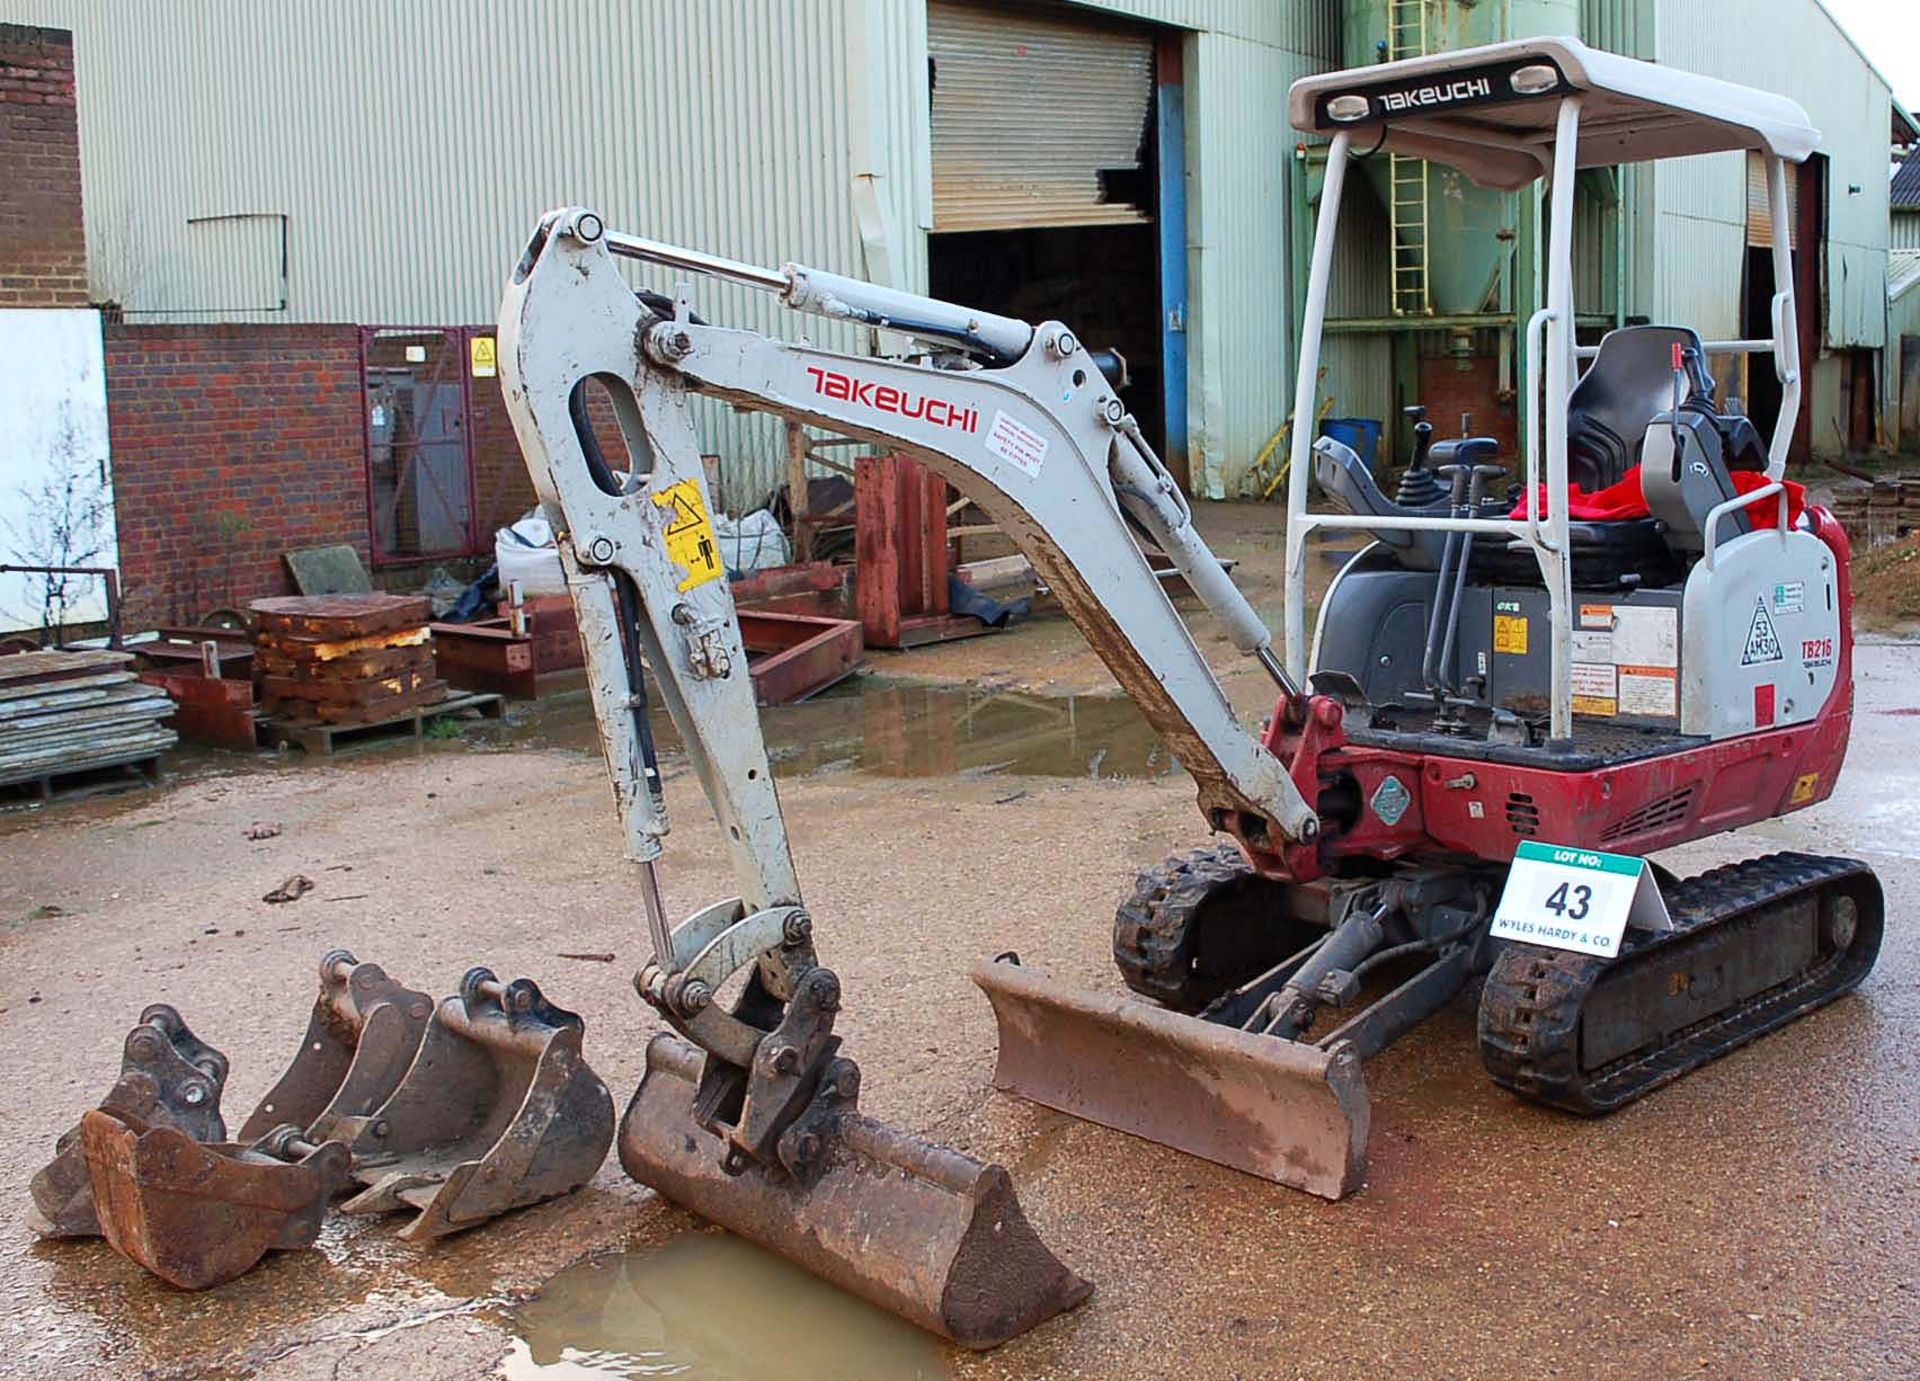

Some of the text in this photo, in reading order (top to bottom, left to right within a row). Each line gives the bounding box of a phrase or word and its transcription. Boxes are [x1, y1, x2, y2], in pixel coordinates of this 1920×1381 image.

[1755, 621, 1768, 638] 53
[1802, 639, 1833, 659] TB216
[1553, 850, 1602, 867] LOT NO:
[1545, 882, 1592, 920] 43
[1499, 918, 1535, 934] WYLES
[1537, 925, 1578, 941] HARDY
[1579, 933, 1588, 944] &
